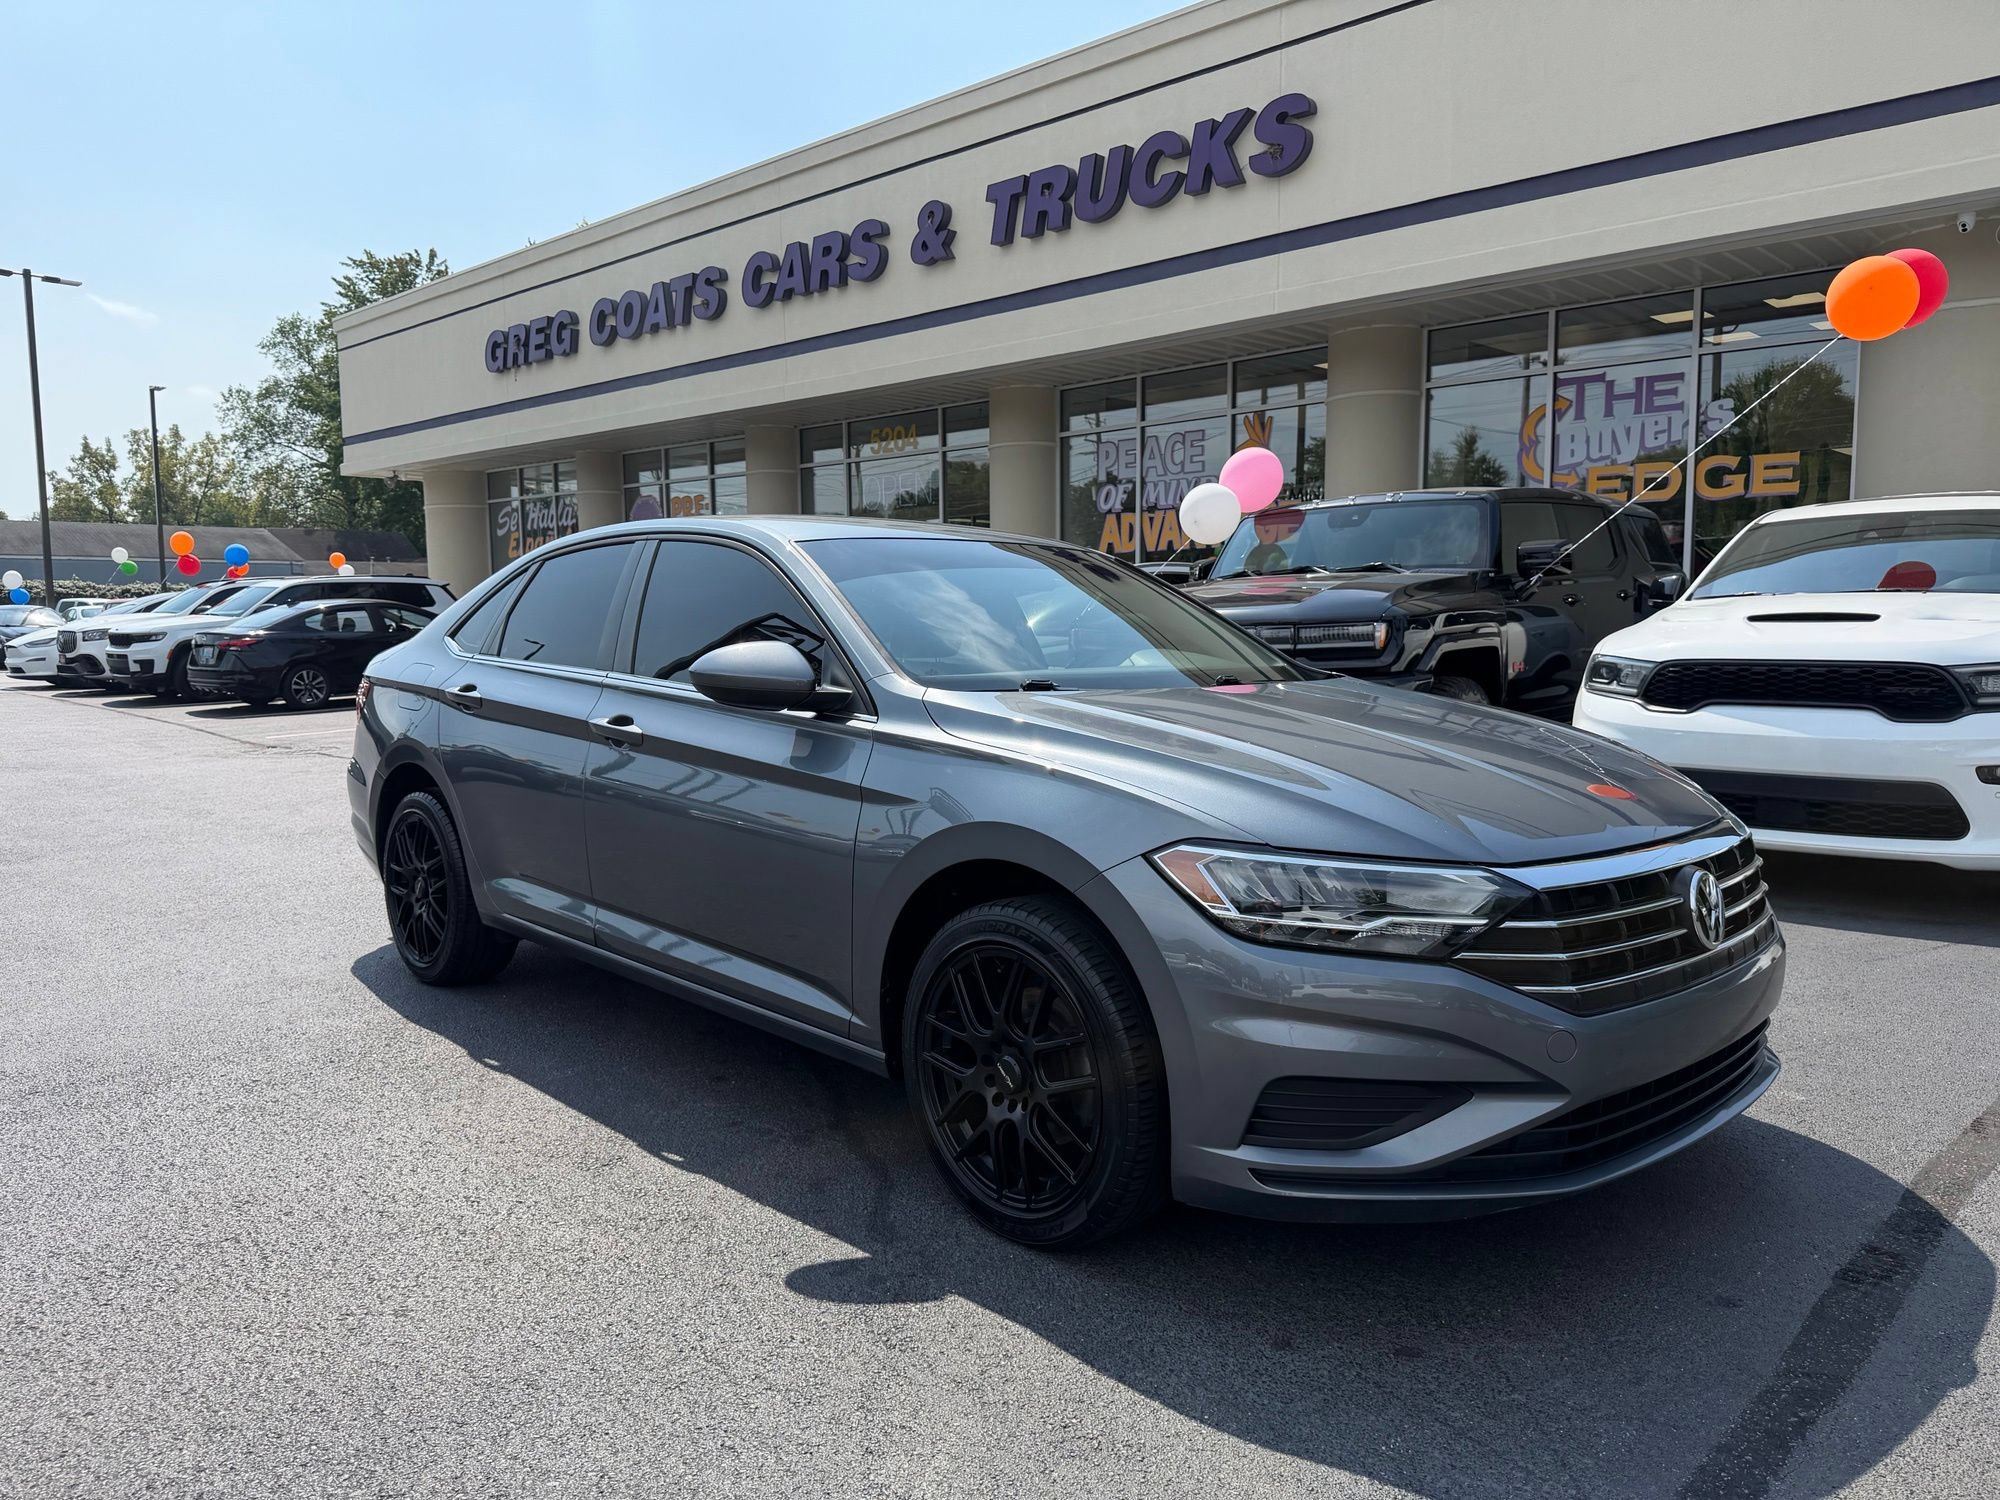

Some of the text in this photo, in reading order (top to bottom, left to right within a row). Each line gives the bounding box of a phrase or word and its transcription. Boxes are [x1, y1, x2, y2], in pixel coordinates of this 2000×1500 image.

[484, 92, 1317, 374] GREG COATS CARS & TRUCKS
[1556, 371, 1685, 421] THE
[870, 423, 919, 455] 5204
[1097, 429, 1206, 480] PEACE
[863, 470, 933, 512] OPEN
[1096, 475, 1219, 514] OF MIN
[1586, 451, 1801, 502] EDGE
[496, 505, 519, 537] Se
